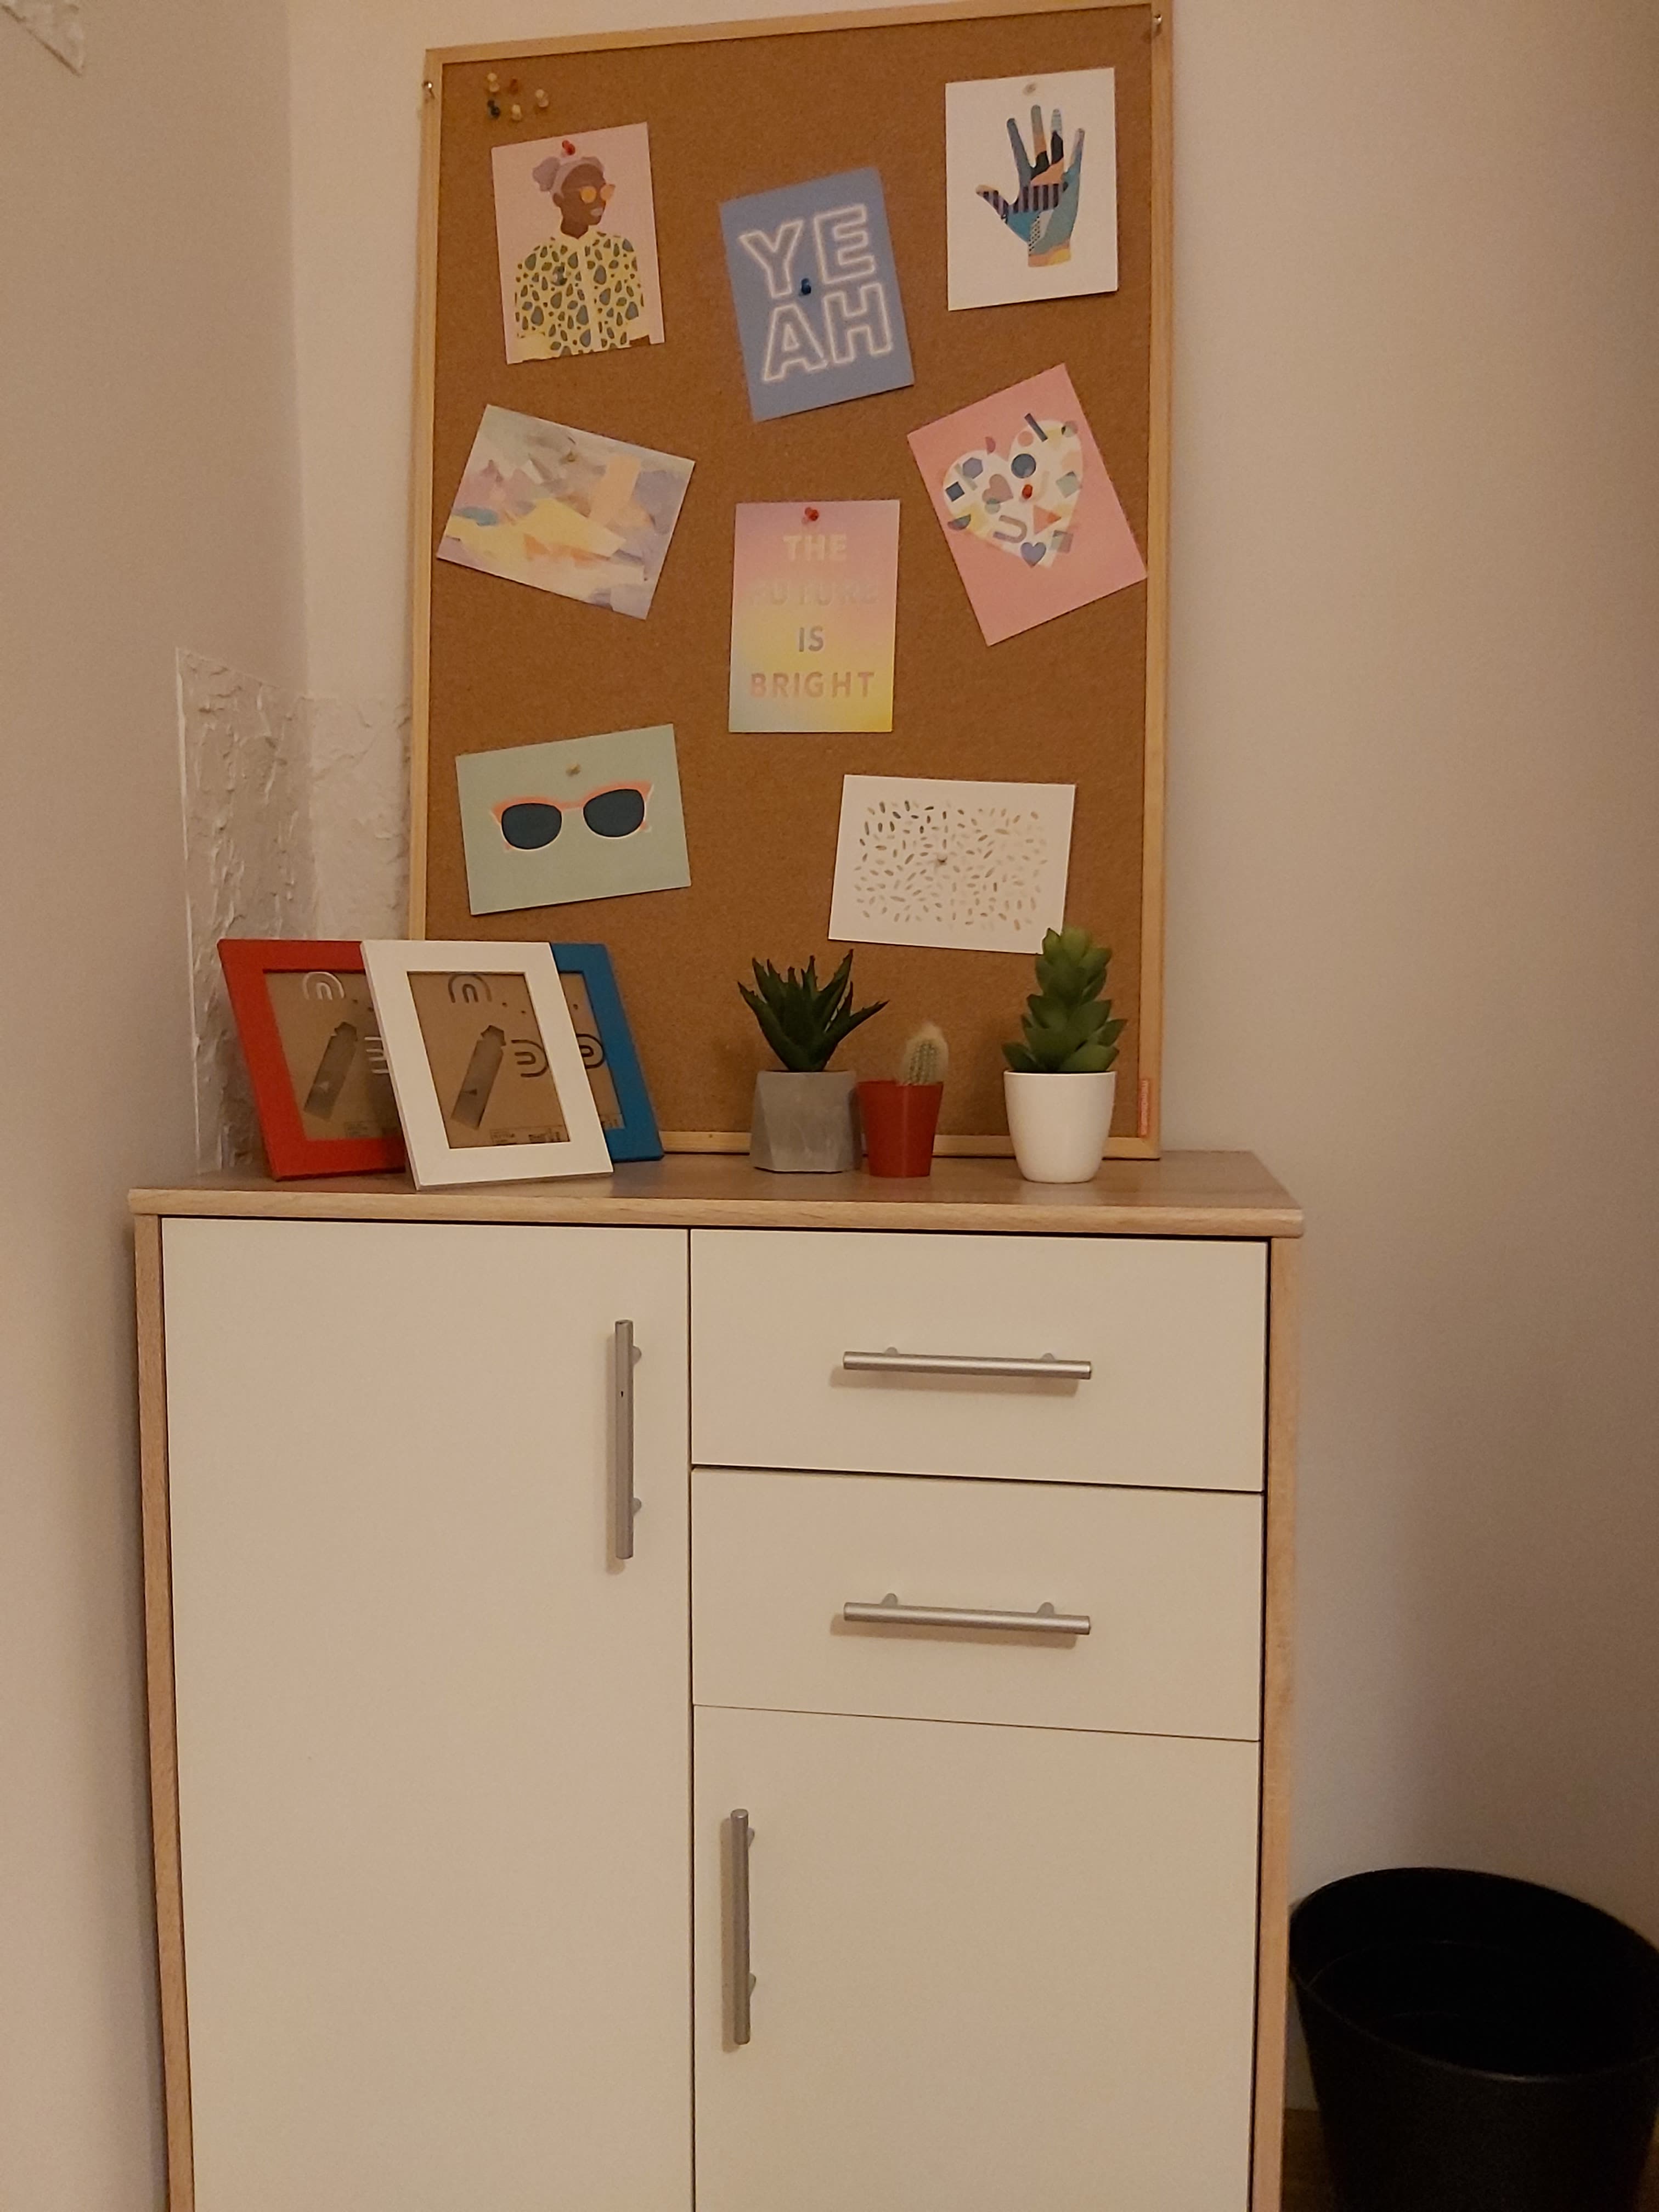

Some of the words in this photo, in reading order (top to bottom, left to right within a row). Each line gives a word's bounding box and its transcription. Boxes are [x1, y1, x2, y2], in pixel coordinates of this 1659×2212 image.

[738, 204, 877, 299] YE
[761, 282, 893, 382] AH
[783, 534, 848, 561] THE
[798, 625, 824, 652] IS
[750, 671, 875, 698] BRIGHT
